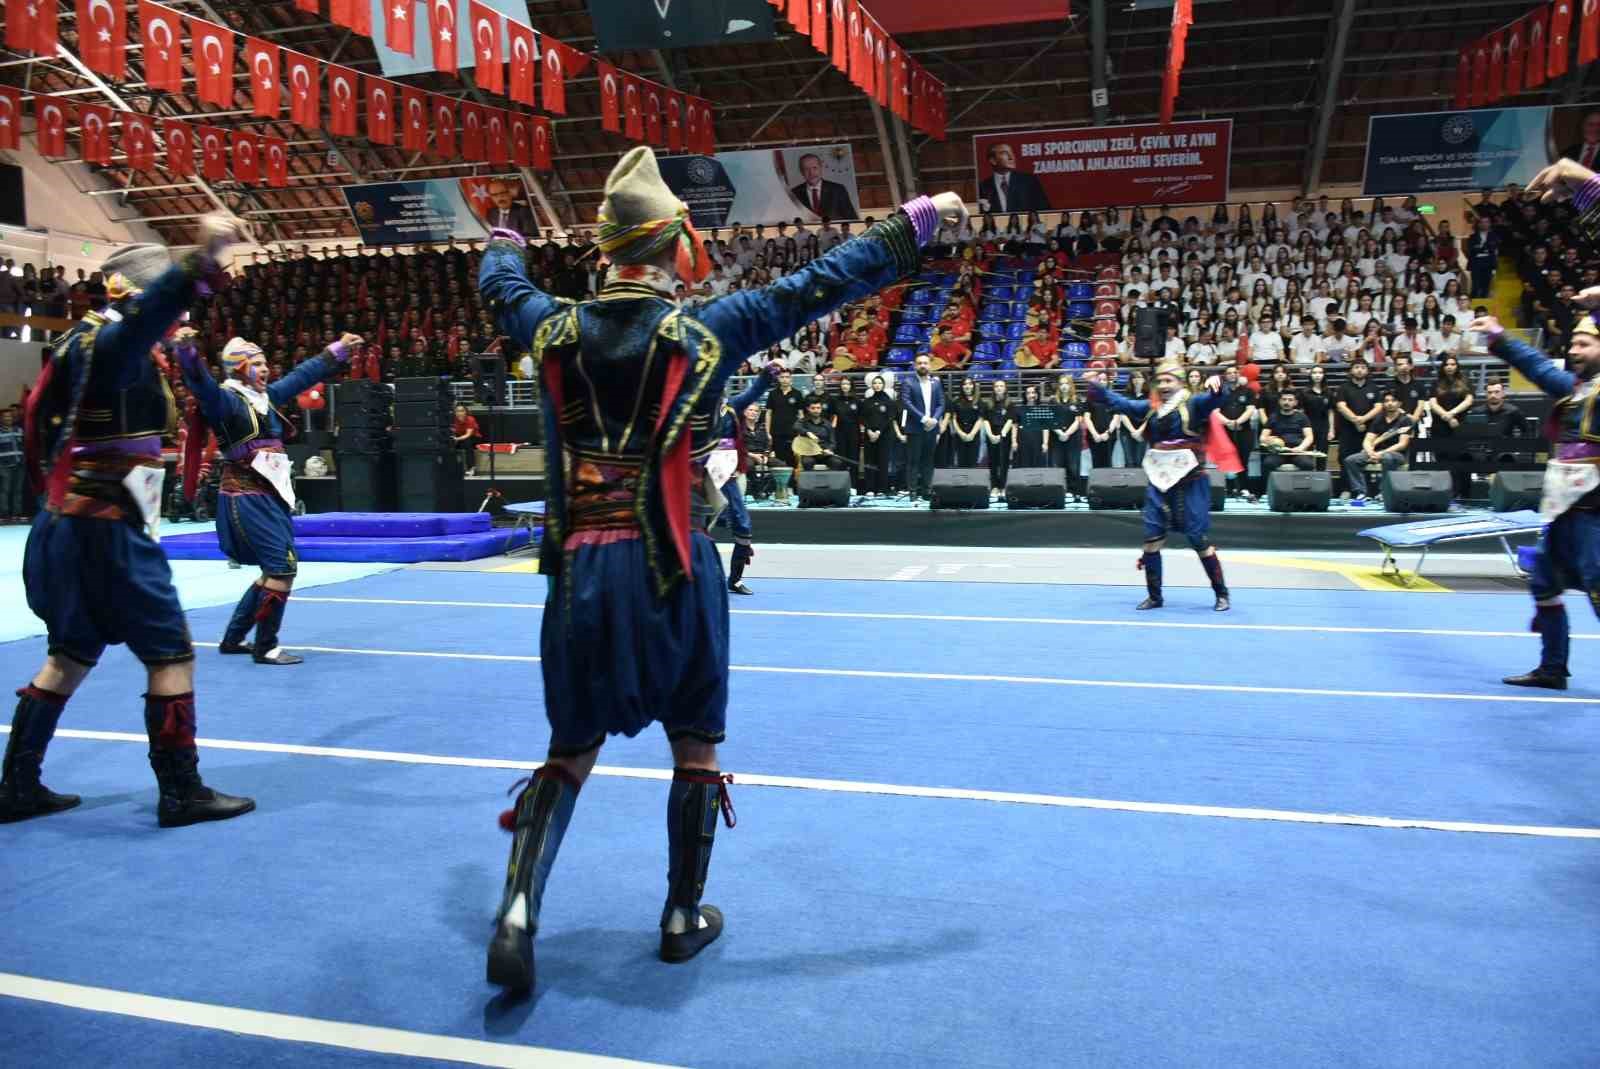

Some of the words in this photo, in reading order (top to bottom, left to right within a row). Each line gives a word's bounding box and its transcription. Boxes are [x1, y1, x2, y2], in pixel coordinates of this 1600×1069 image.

[1021, 143, 1042, 157] BEN
[1044, 139, 1108, 157] SPORCUNUN
[1140, 132, 1171, 154] ÇEVİK
[1174, 133, 1188, 148] VE
[1190, 132, 1217, 147] AYNI
[1032, 158, 1085, 174] ZAMANDA
